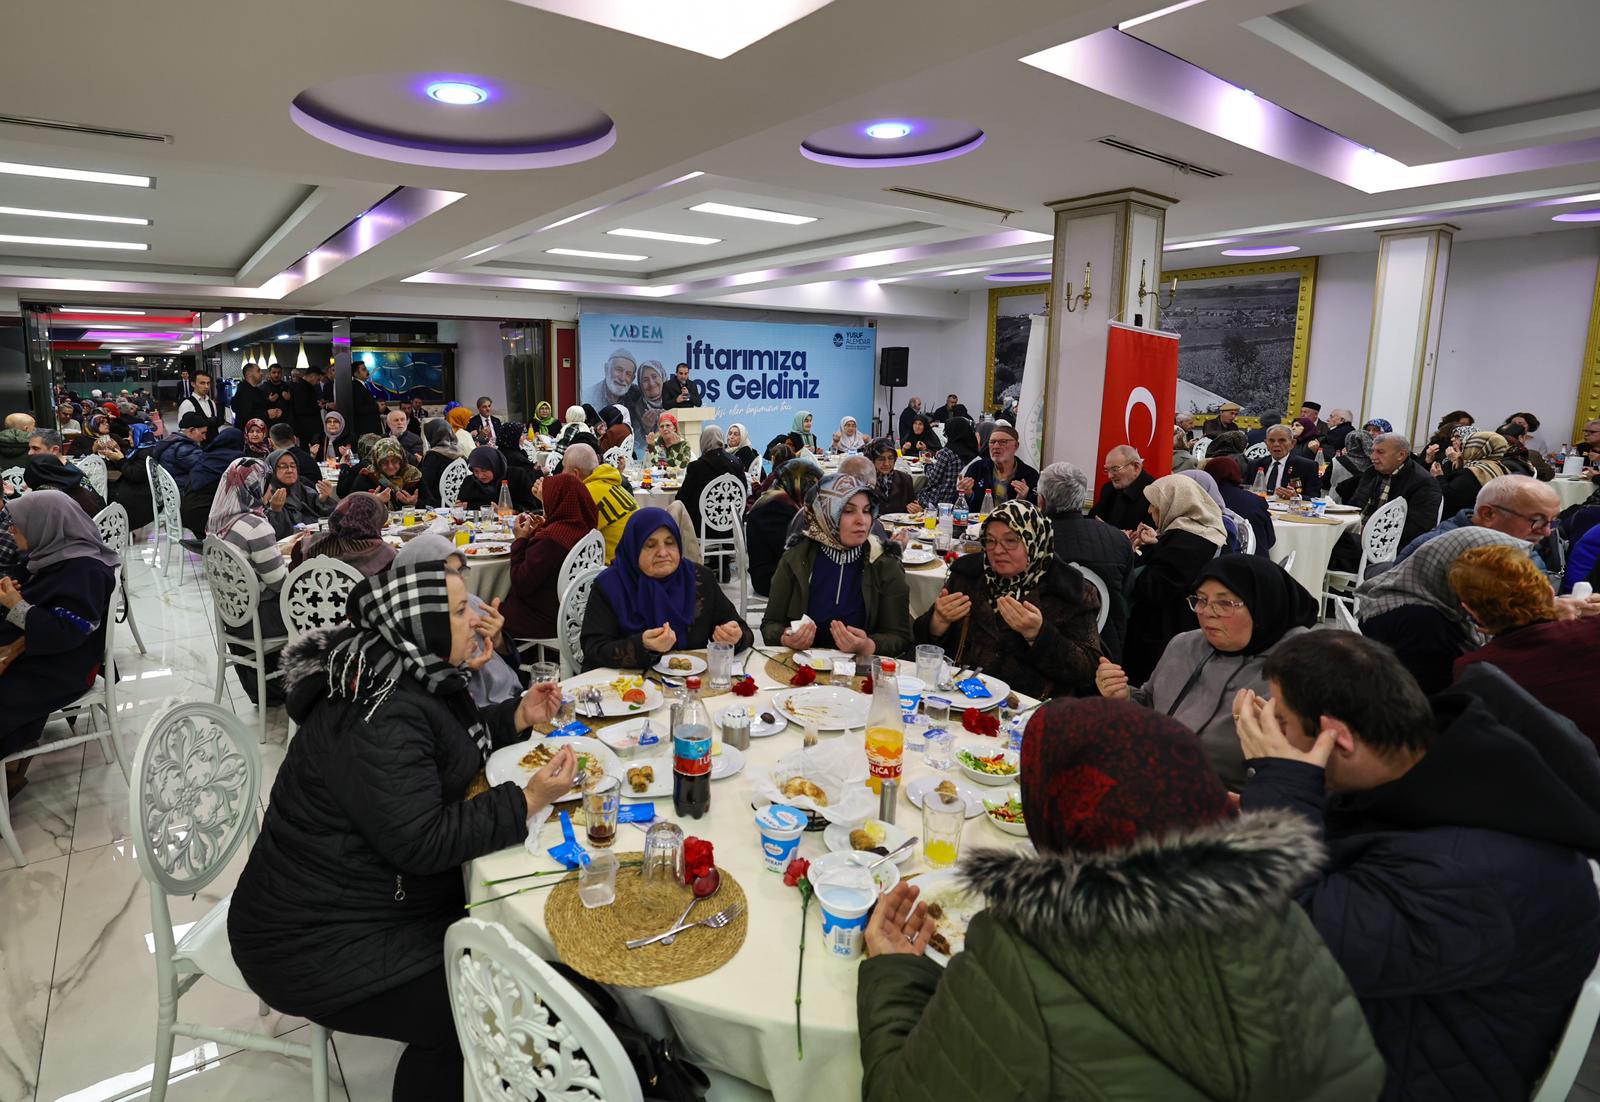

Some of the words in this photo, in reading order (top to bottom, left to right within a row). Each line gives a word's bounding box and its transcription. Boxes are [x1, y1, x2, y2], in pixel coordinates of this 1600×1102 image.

[610, 323, 663, 339] YADEM
[686, 335, 807, 371] İftarımıza
[670, 373, 720, 402] oş
[727, 371, 820, 400] Geldiniz
